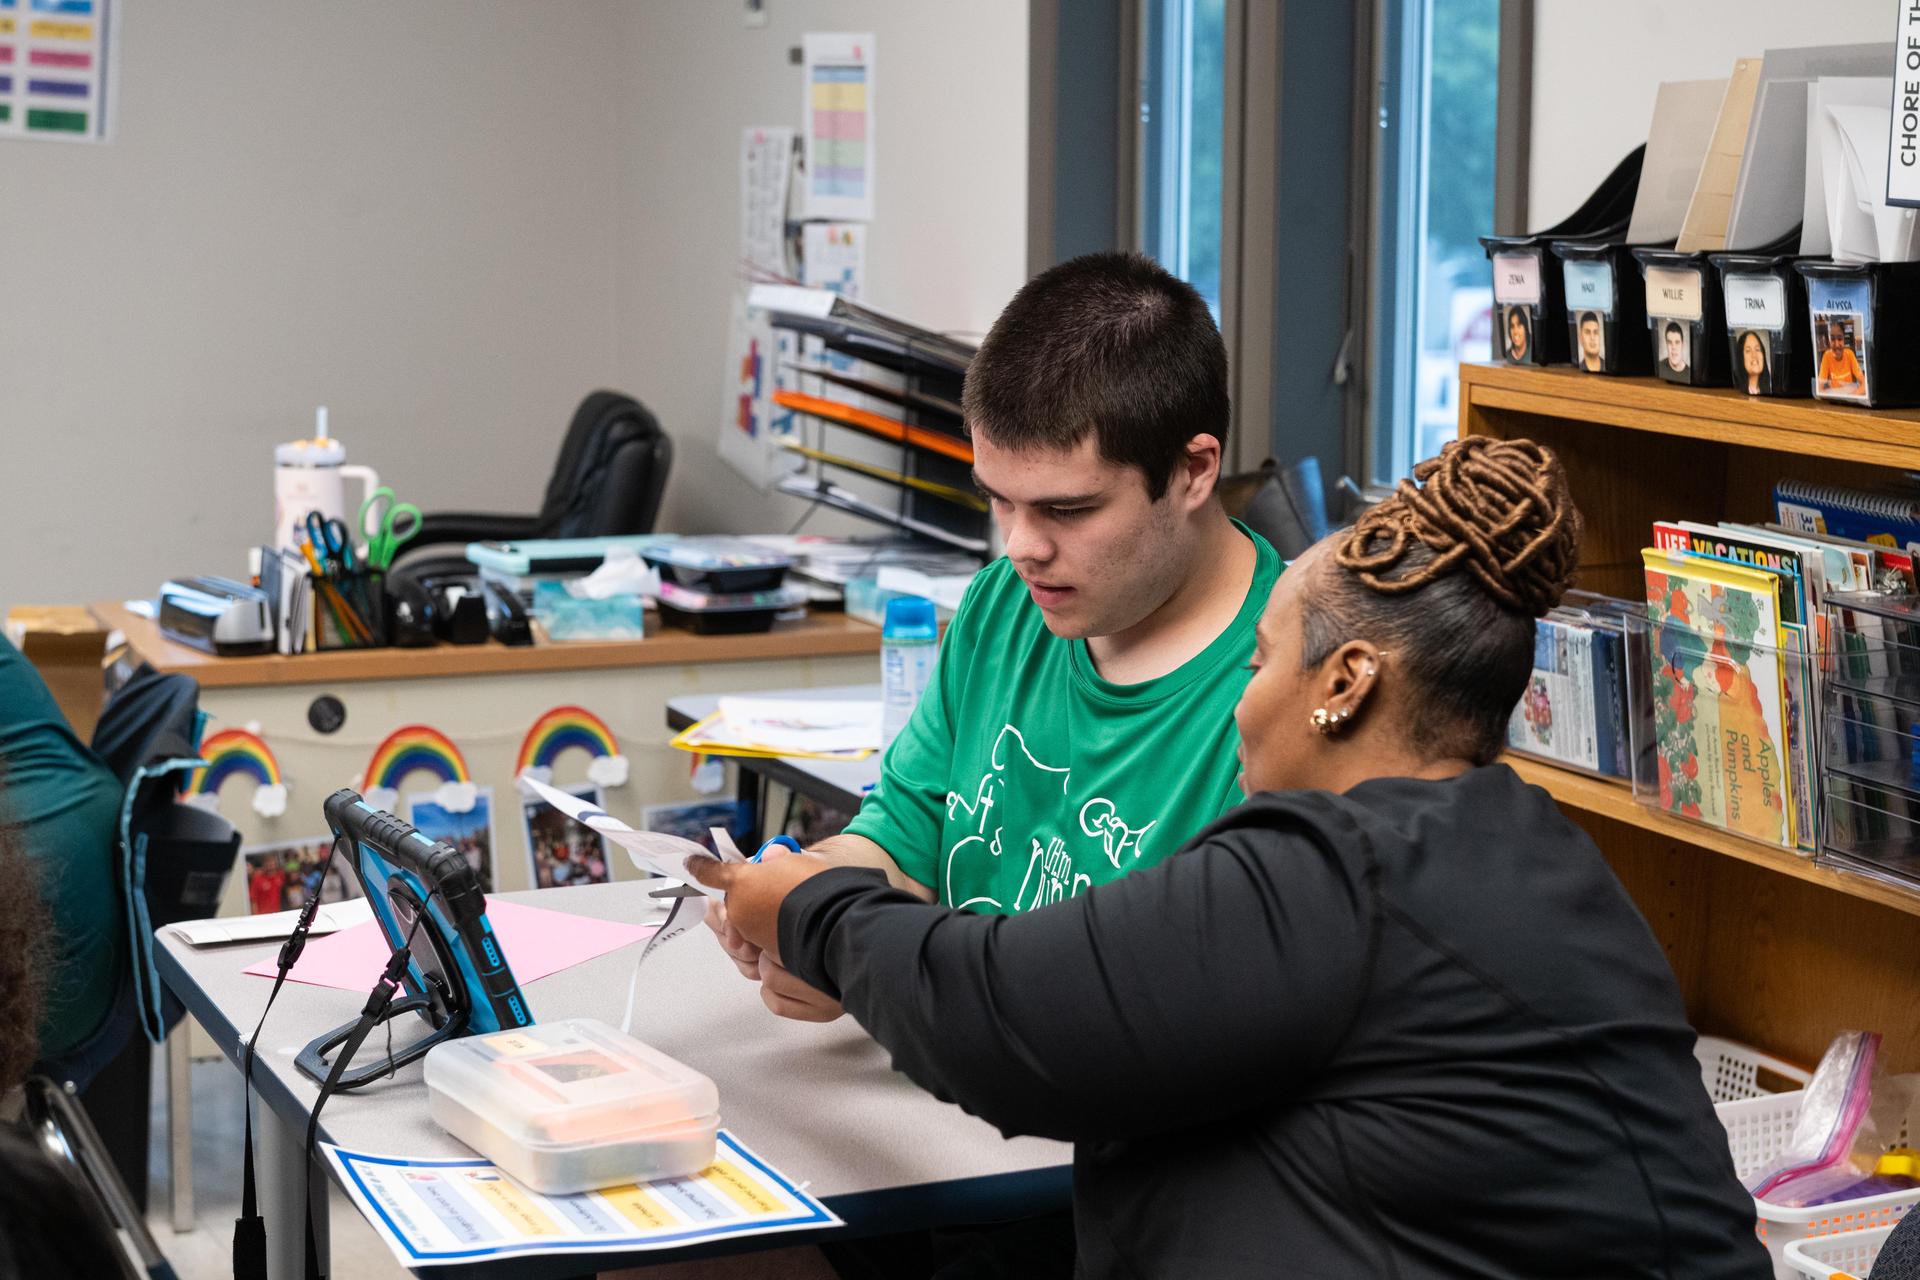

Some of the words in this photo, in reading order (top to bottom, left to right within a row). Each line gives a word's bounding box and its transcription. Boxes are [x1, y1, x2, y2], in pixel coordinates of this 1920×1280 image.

[1906, 36, 1920, 70] OF
[1901, 81, 1920, 167] CHORE
[1662, 288, 1684, 301] WILLIE
[1744, 297, 1765, 310] TRINA
[1741, 734, 1757, 773] and
[1755, 738, 1775, 807] Apples
[1725, 729, 1743, 820] Pumpkins
